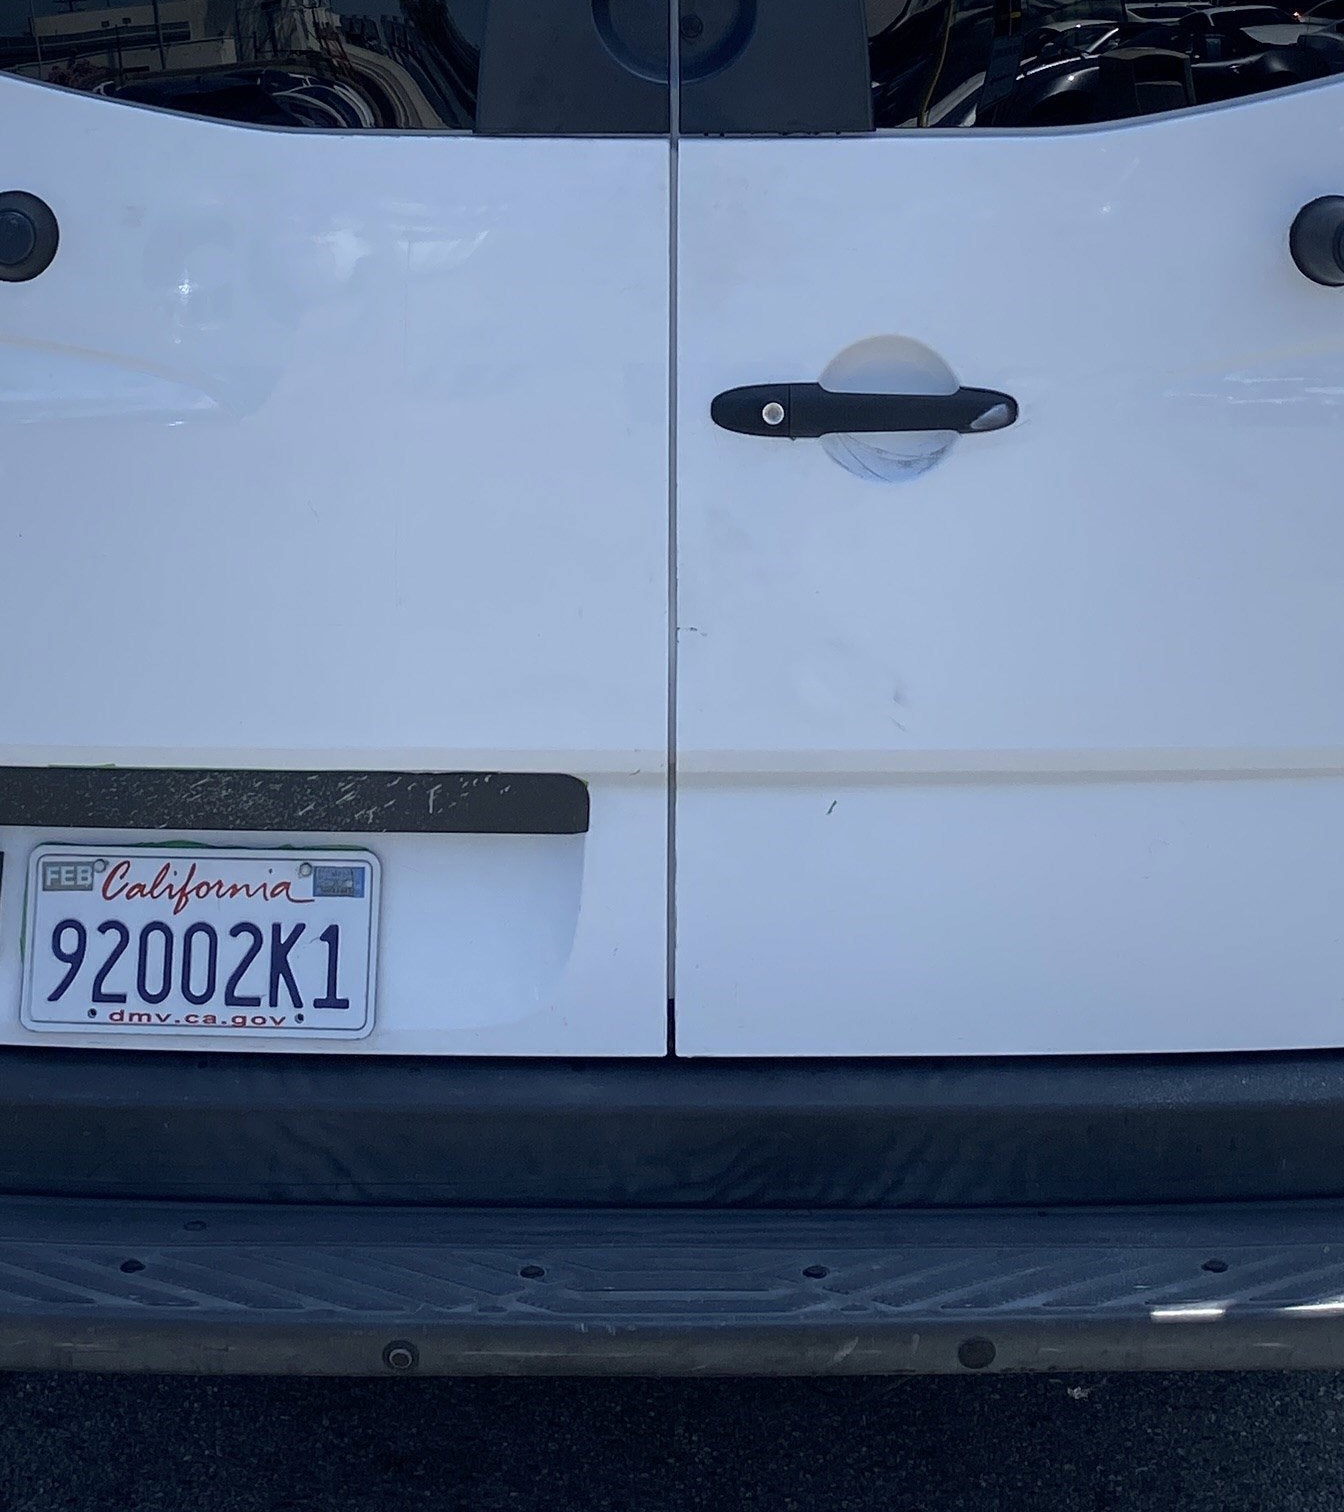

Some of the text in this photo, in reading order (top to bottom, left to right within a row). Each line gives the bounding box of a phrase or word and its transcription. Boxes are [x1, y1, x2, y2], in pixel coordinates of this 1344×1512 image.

[45, 865, 93, 888] FEB
[101, 860, 315, 915] California
[47, 919, 350, 1009] 92002K1
[108, 1009, 287, 1027] dmv.ca.gov
